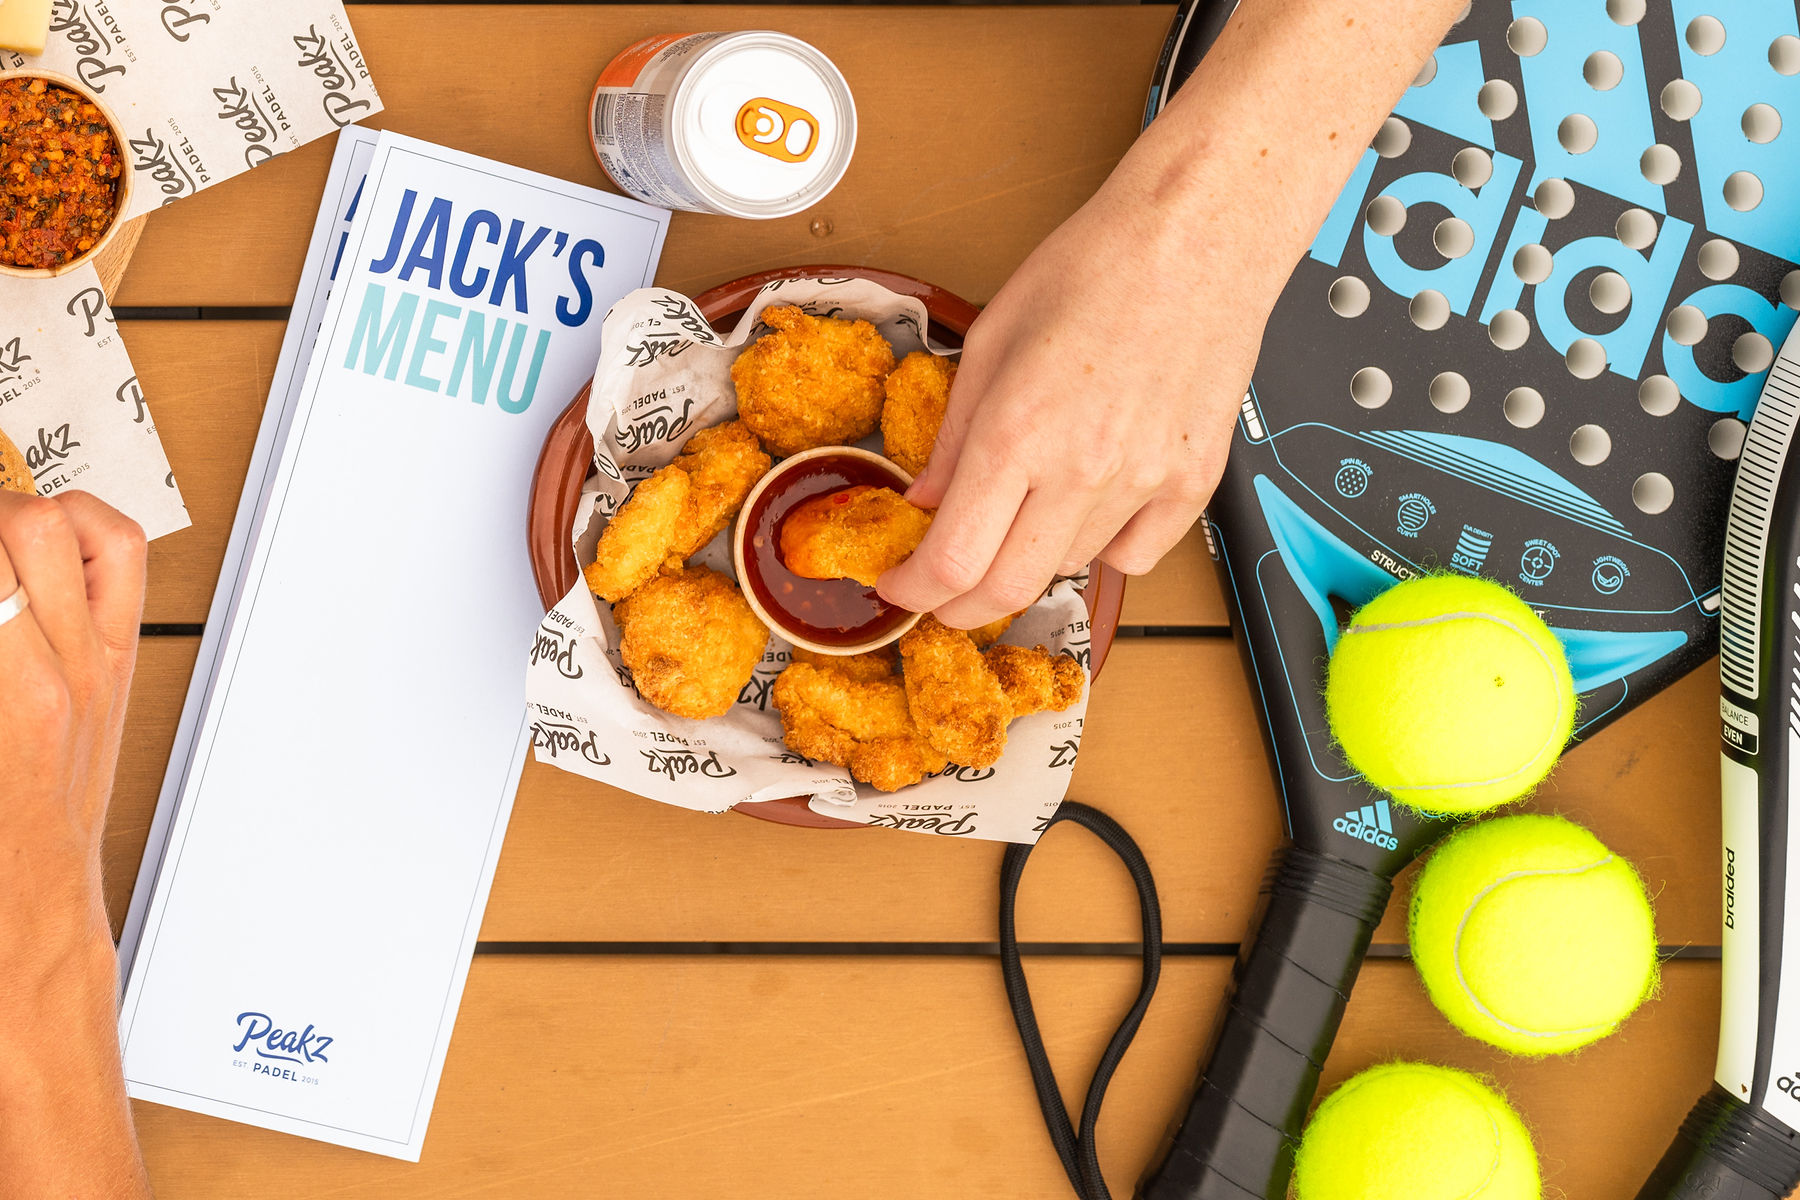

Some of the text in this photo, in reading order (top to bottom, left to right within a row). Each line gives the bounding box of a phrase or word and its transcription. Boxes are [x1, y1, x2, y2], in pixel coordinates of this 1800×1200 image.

[92, 0, 126, 44] PADEL
[339, 34, 371, 79] PADEL
[293, 25, 370, 128] Peakz
[262, 85, 292, 131] PADEL
[178, 136, 212, 183] PADEL
[369, 188, 605, 328] JACK'S
[343, 282, 552, 415] MENU
[22, 376, 42, 391] 2015
[633, 388, 667, 410] PADEL
[71, 463, 90, 477] 2015
[1340, 458, 1373, 476] SPIN BLADE
[1398, 493, 1437, 515] SMART HOLES
[1396, 526, 1418, 538] CURVE
[1451, 552, 1483, 571] SOFT
[1524, 539, 1560, 559] SWEET SPOT
[1371, 550, 1422, 583] STRUCT
[1518, 572, 1544, 586] CENTER
[1592, 555, 1631, 577] LIGHTWEIGHT
[536, 703, 573, 721] PADEL
[529, 722, 611, 766] Peakz
[650, 731, 692, 746] PADEL
[1723, 723, 1743, 745] EVEN
[640, 750, 737, 782] Peakz
[1332, 814, 1398, 851] adidas
[1724, 846, 1736, 930] braided
[233, 1011, 334, 1063] Peakz
[232, 1059, 319, 1085] EST. PADEL 2015
